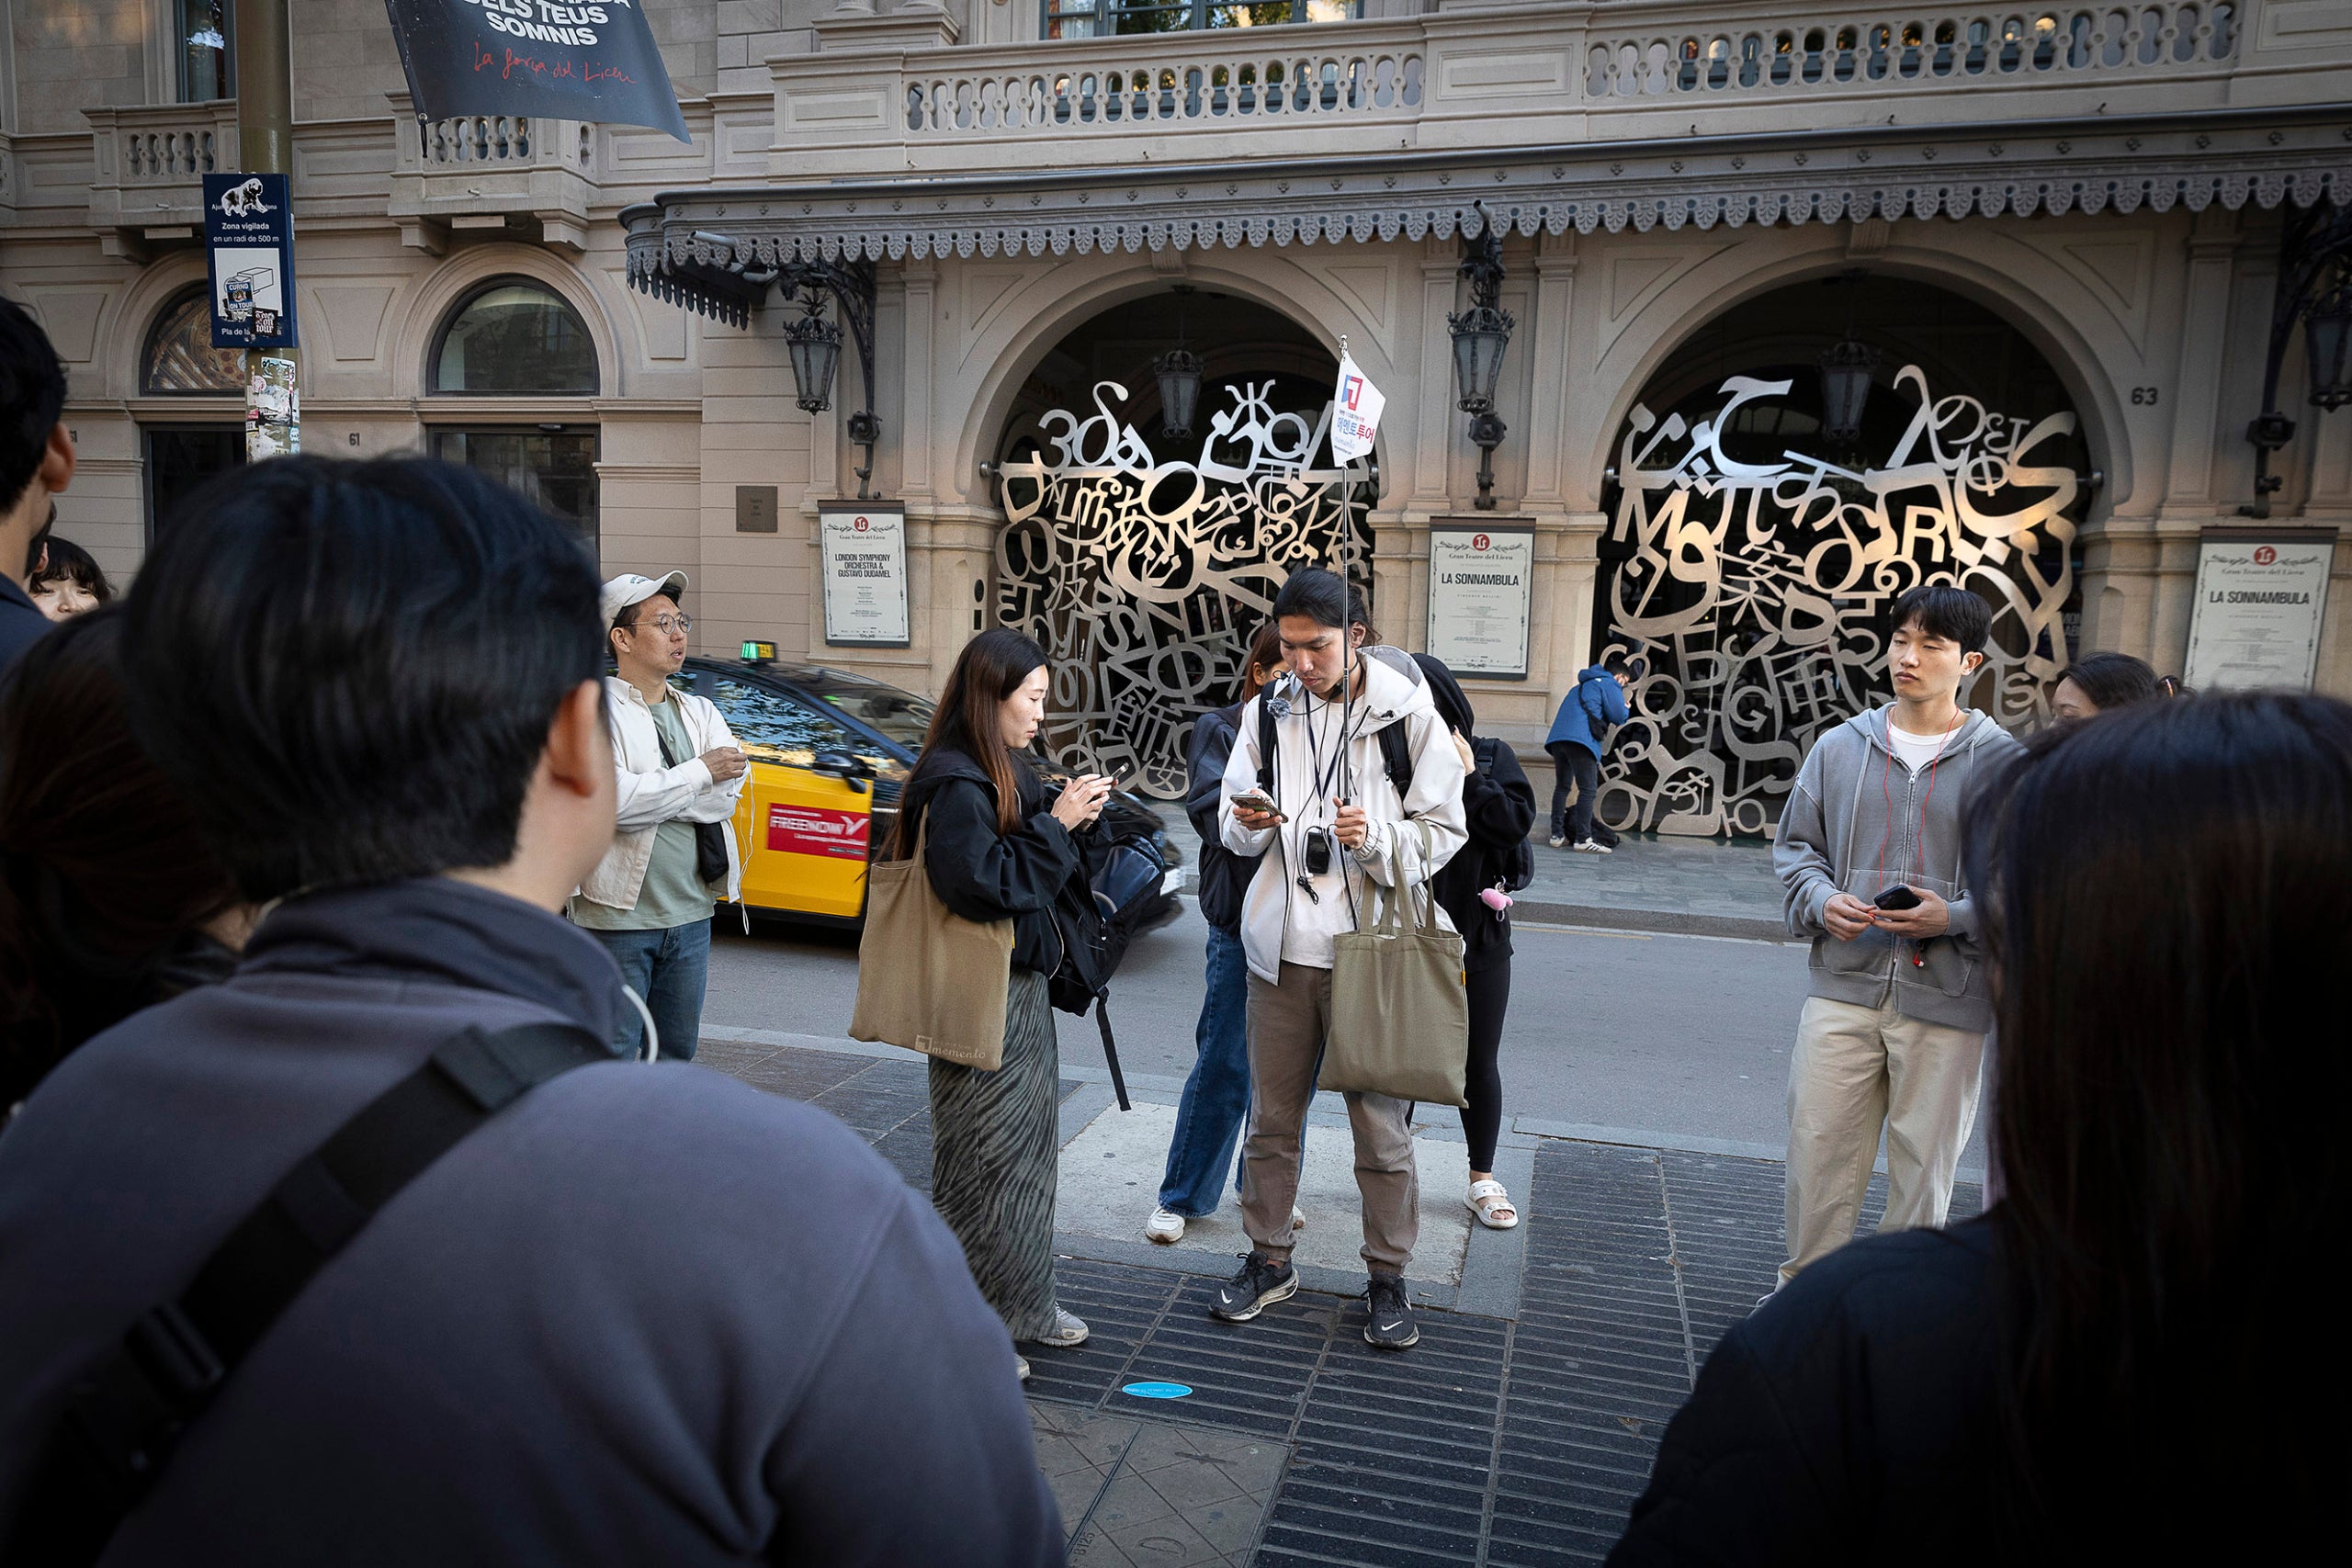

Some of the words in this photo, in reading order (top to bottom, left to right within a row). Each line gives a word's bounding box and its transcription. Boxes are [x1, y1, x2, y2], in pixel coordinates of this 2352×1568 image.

[464, 0, 533, 18] ELS
[537, 1, 609, 25] TEUS
[485, 11, 598, 46] SOMNIS
[474, 41, 494, 73] La
[241, 222, 270, 231] vigilada
[2132, 387, 2158, 405] 63
[349, 433, 360, 446] 61
[835, 553, 858, 561] LONDON
[858, 553, 891, 561] SYMPHONY
[844, 561, 878, 570] ORCHESTRA
[878, 561, 884, 570] &
[838, 570, 863, 578] GUSTAVO
[864, 570, 891, 578] DUDAMEL
[1442, 573, 1453, 584] LA
[1455, 573, 1519, 586] SONNAMBULA
[2209, 592, 2224, 604] LA
[2227, 591, 2310, 604] SONNAMBULA
[770, 815, 845, 835] FREENOW
[932, 1046, 986, 1059] memento
